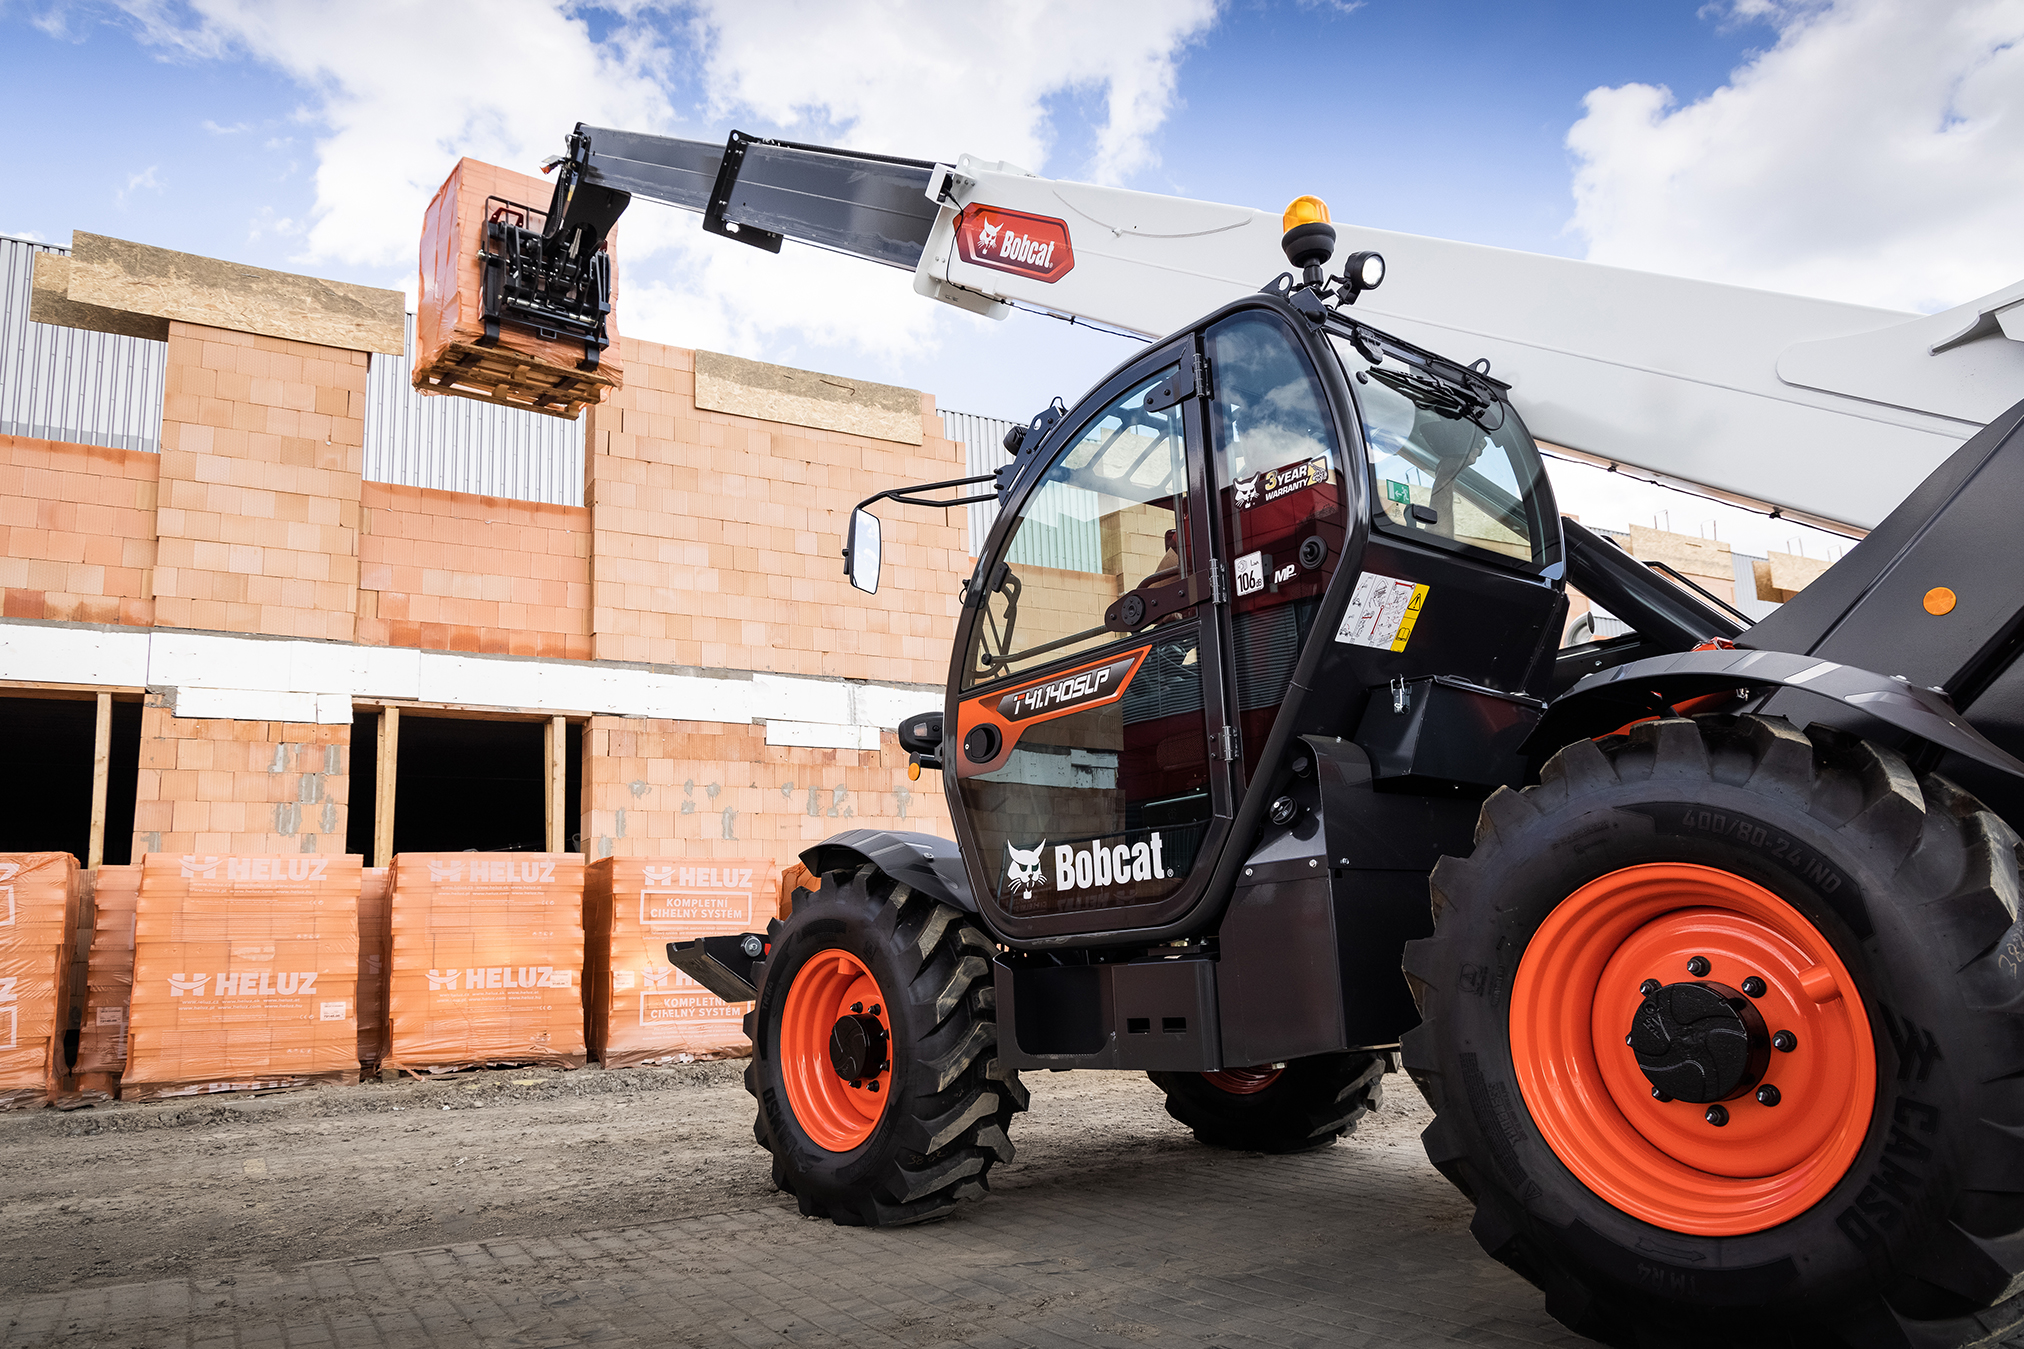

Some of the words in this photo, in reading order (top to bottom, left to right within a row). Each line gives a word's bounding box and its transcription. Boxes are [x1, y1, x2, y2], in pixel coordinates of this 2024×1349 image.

[1000, 230, 1055, 268] Bobcat
[1265, 470, 1278, 490] 3
[1277, 465, 1307, 486] YEAR
[1265, 477, 1309, 501] WARRANTY
[1237, 570, 1256, 592] 106
[1274, 564, 1297, 584] MP
[1013, 667, 1111, 715] T41.140SLP
[228, 858, 327, 881] HELUZ
[470, 861, 556, 883] HELUZ
[1054, 831, 1166, 892] Bobcat
[679, 867, 753, 888] HELUZ
[650, 907, 698, 918] CIHELNÝ
[701, 907, 742, 919] SYSTÉM
[666, 896, 729, 908] KOMPLETNÍ
[215, 971, 319, 996] HELUZ
[464, 966, 553, 990] HELUZ
[650, 1005, 696, 1018] CIHELNÝ
[698, 1005, 741, 1016] SYSTÉM
[1835, 1094, 1942, 1255] CAMSO
